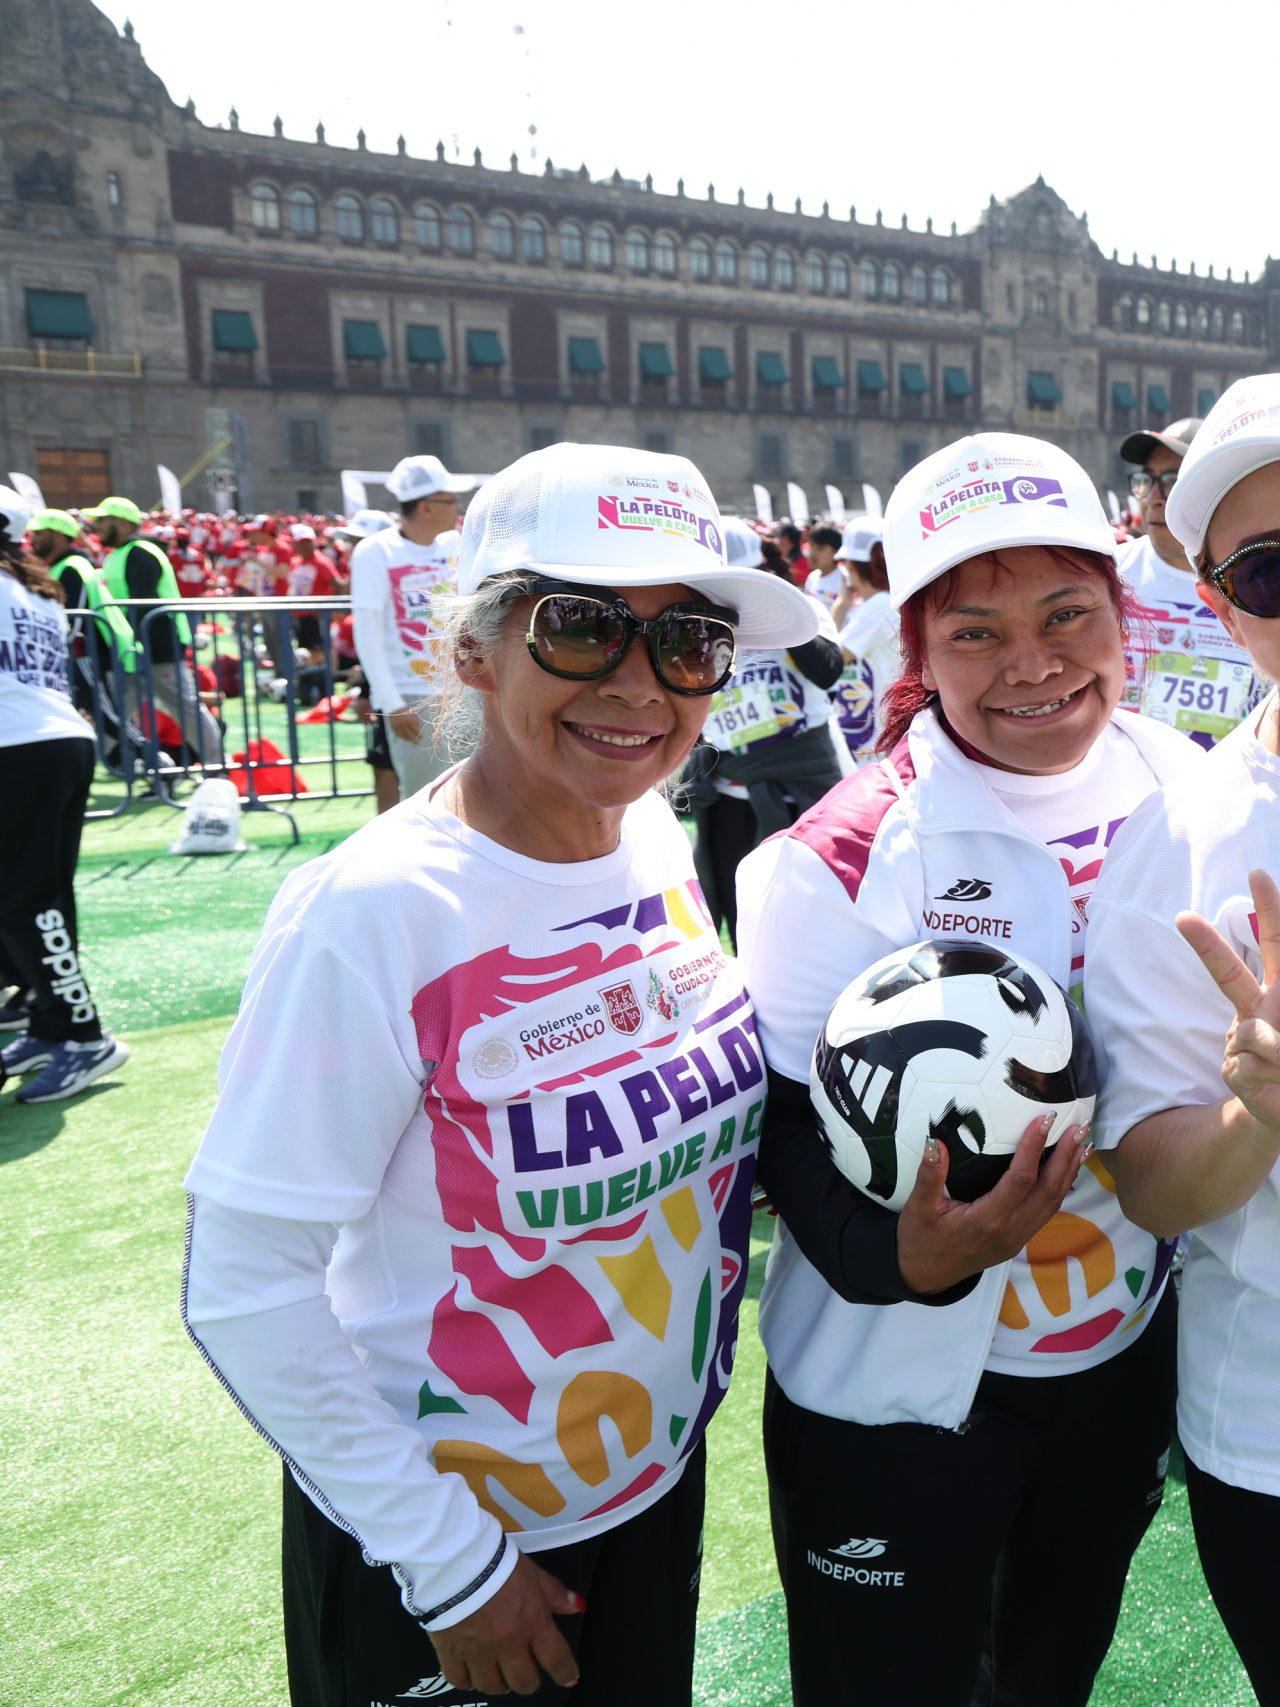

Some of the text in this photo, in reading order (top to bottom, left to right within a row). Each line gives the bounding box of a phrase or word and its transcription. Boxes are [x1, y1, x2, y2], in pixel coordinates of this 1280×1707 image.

[620, 501, 698, 526] LA PELOTA
[933, 481, 1002, 516] LA PELOTA
[935, 492, 1004, 525] VUELVE A CASA
[621, 515, 699, 537] VUELVE A CASA
[1163, 675, 1229, 714] 7581
[714, 701, 760, 735] 1814
[922, 909, 1013, 939] NDEPORTE
[35, 908, 96, 1024] adidas
[675, 972, 710, 995] CIUDAD
[519, 1003, 601, 1043] Gobierno de
[522, 1019, 605, 1061] México
[507, 1089, 624, 1173] LA
[515, 1131, 706, 1229] VUELVE
[709, 1115, 736, 1163] A
[807, 1549, 905, 1587] INDEPORTE
